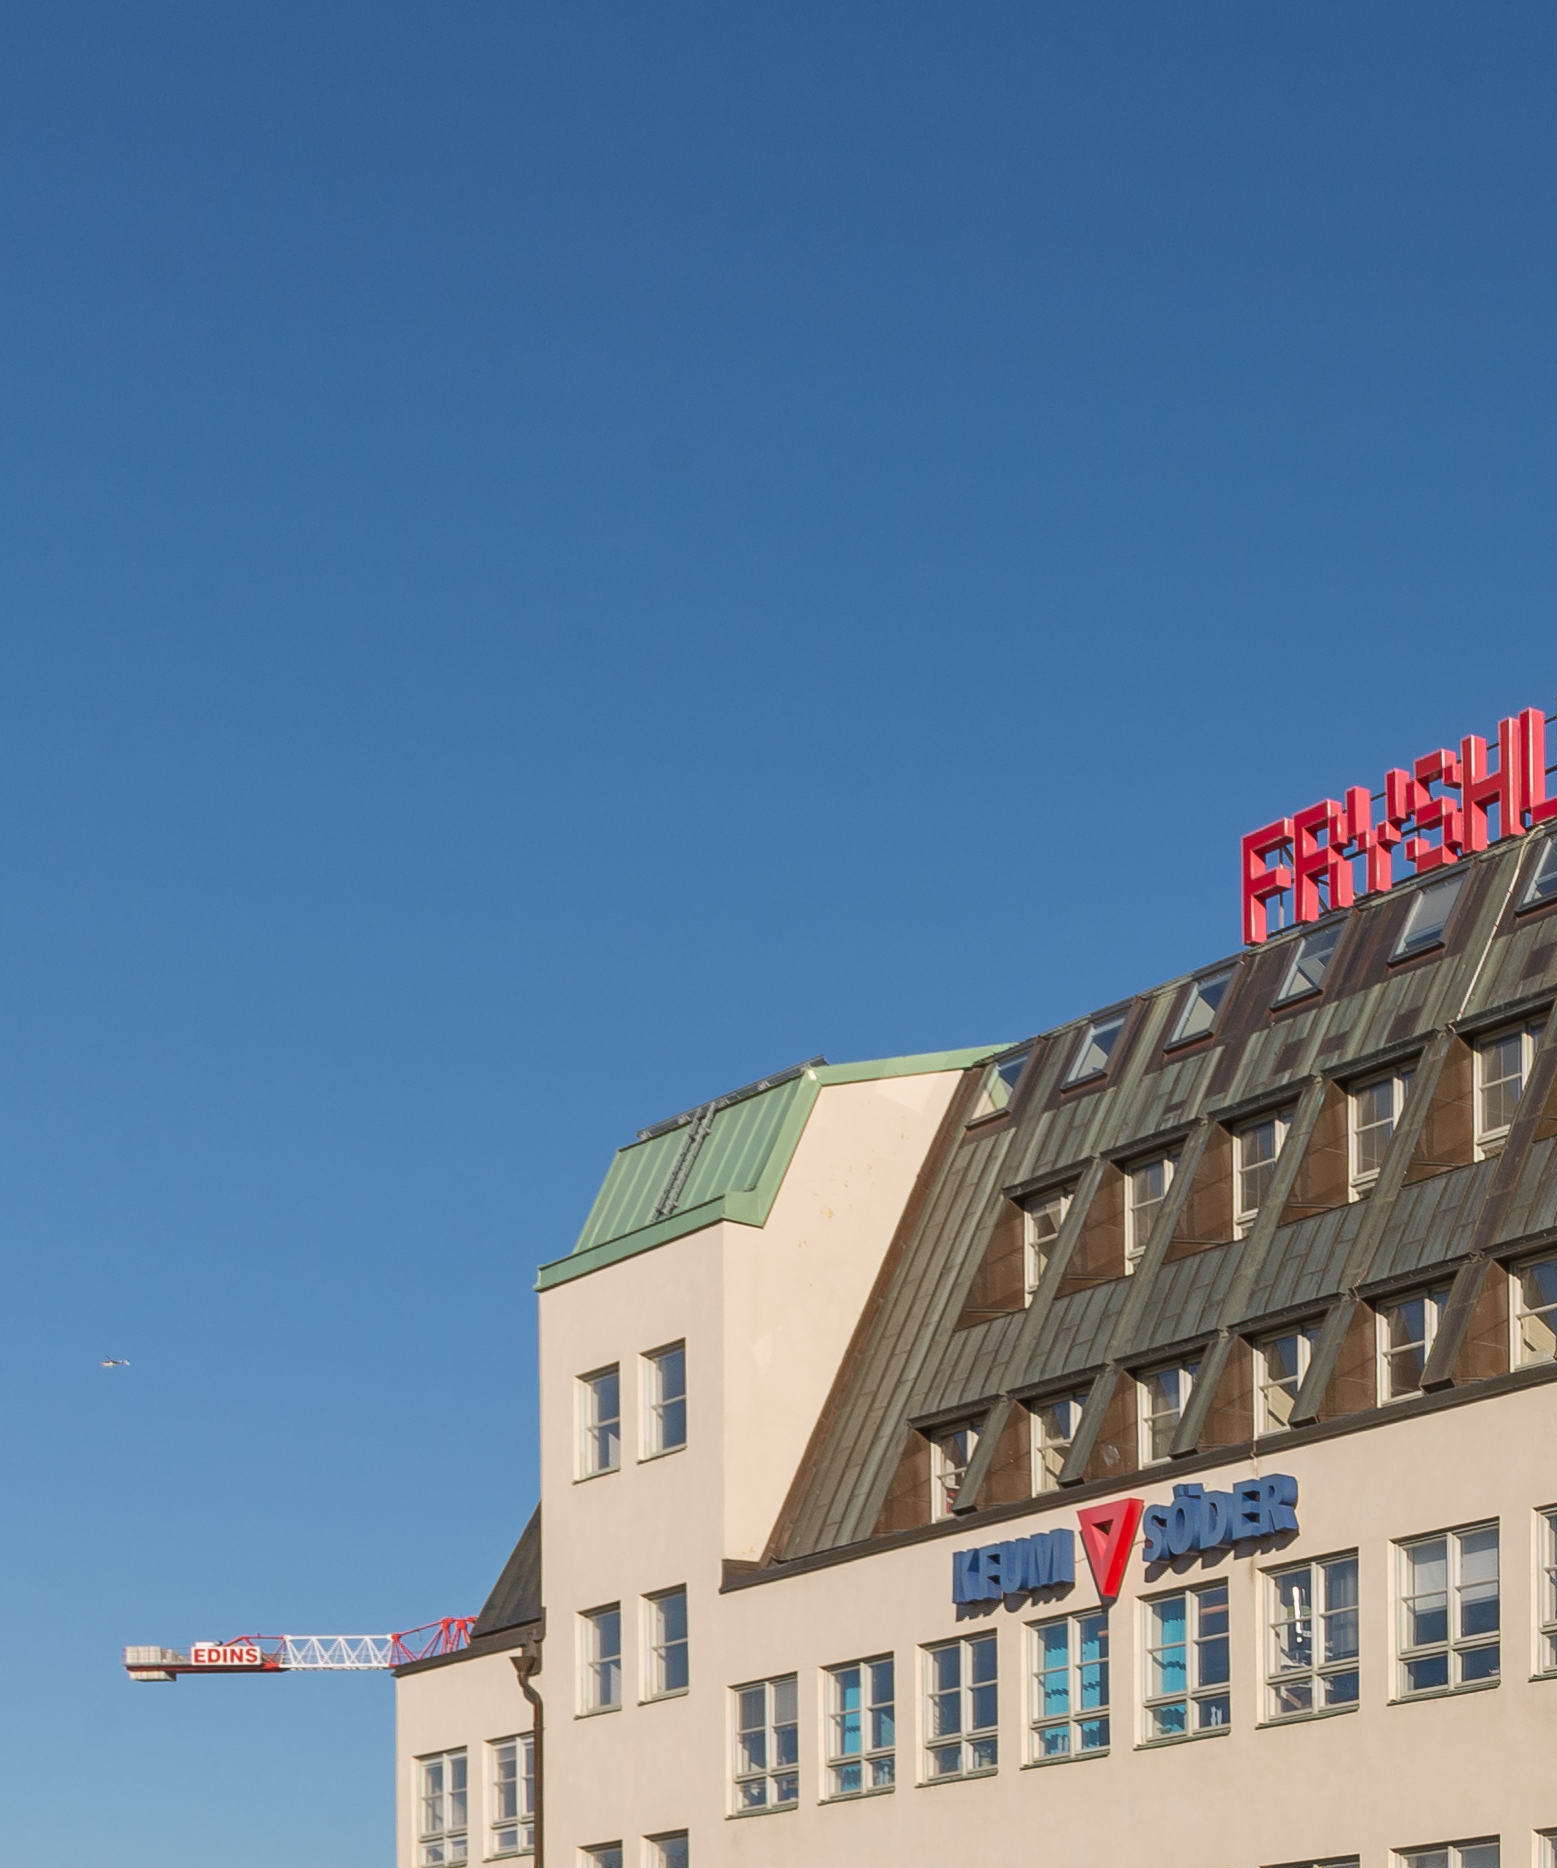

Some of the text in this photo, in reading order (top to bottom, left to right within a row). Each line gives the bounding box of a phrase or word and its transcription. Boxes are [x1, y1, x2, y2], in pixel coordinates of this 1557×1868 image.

[952, 1473, 1299, 1605] KFUM SÖDER
[193, 1646, 259, 1666] EDINS
